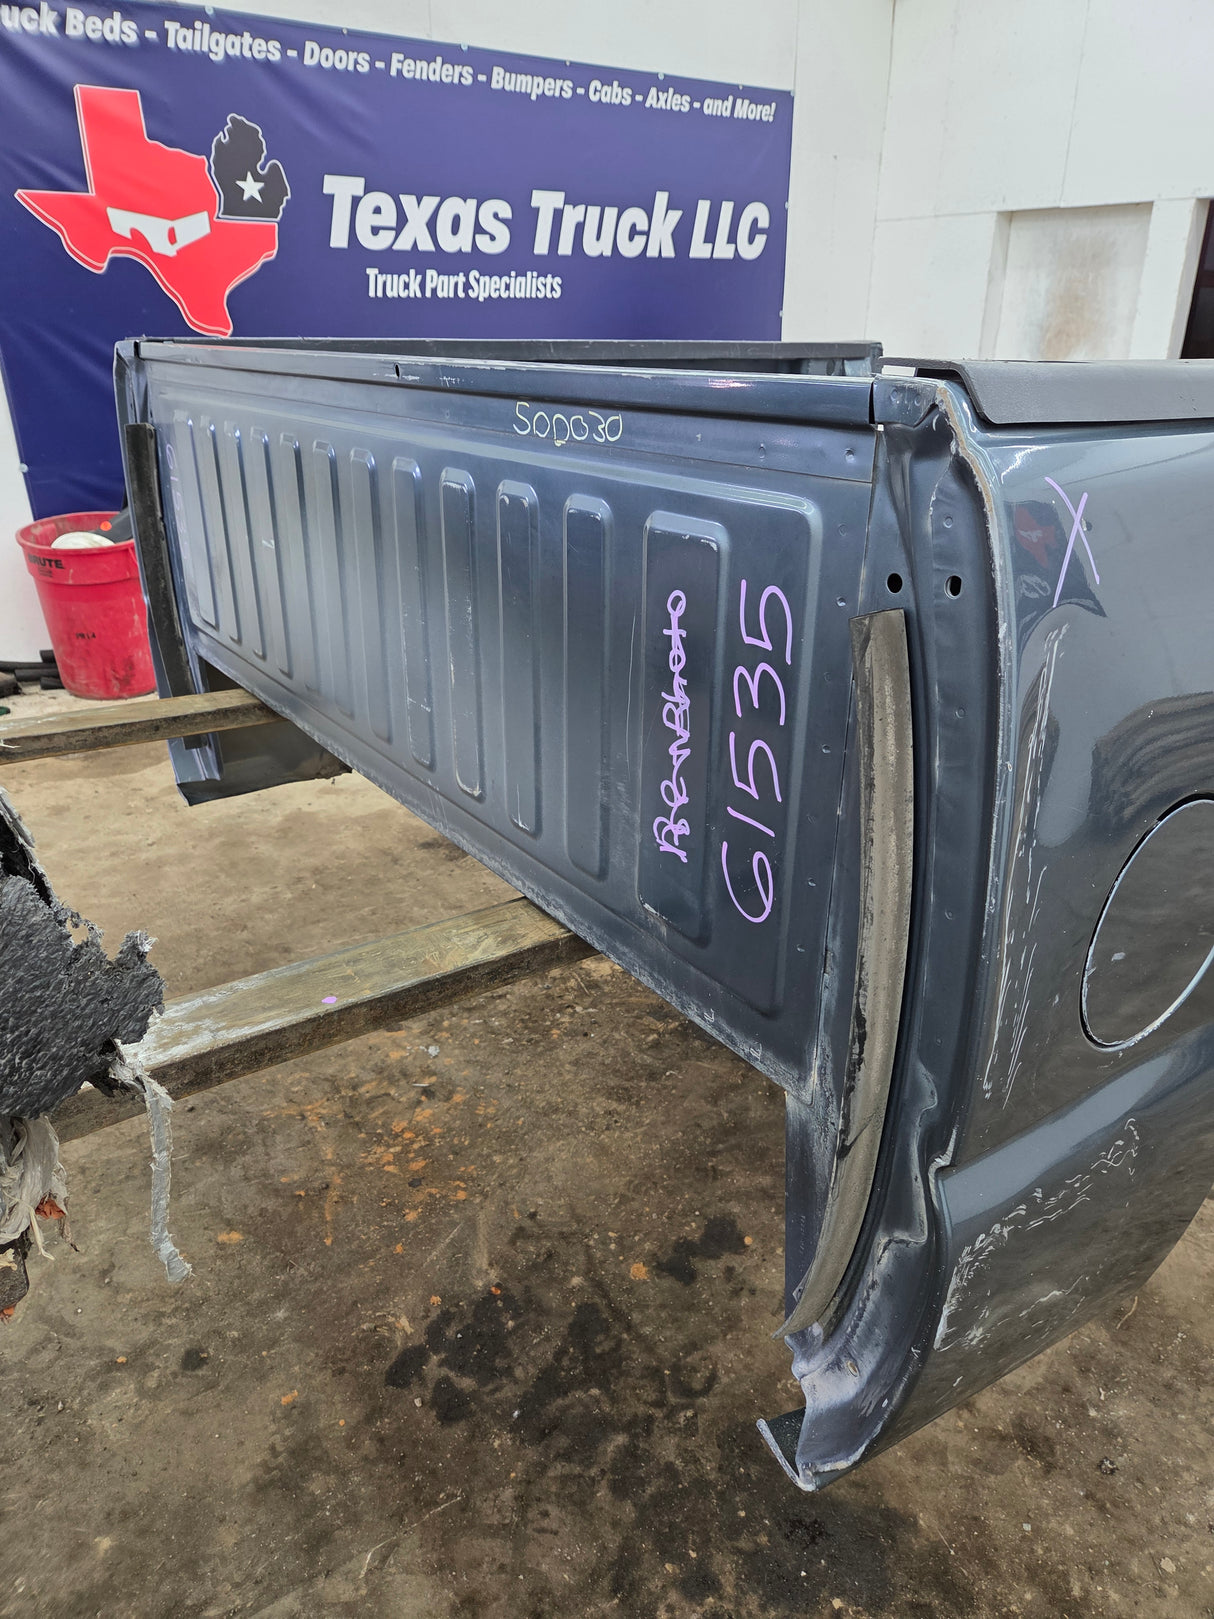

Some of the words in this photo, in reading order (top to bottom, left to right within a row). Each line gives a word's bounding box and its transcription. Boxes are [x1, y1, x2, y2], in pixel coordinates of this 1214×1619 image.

[65, 7, 138, 43] Beds
[164, 20, 282, 61] Tailgates
[303, 41, 370, 73] Doors
[389, 52, 474, 85] Fenders
[490, 66, 574, 100] Bumpers
[588, 80, 633, 106] Cabs
[645, 87, 691, 112] Axles
[703, 95, 734, 117] and
[733, 98, 777, 123] More!
[322, 174, 513, 255] Texas
[530, 189, 684, 258] Truck
[688, 199, 770, 260] LLC
[366, 267, 422, 298] Truck
[425, 269, 466, 299] Part
[468, 269, 562, 301] Specialists
[721, 578, 793, 924] 61535
